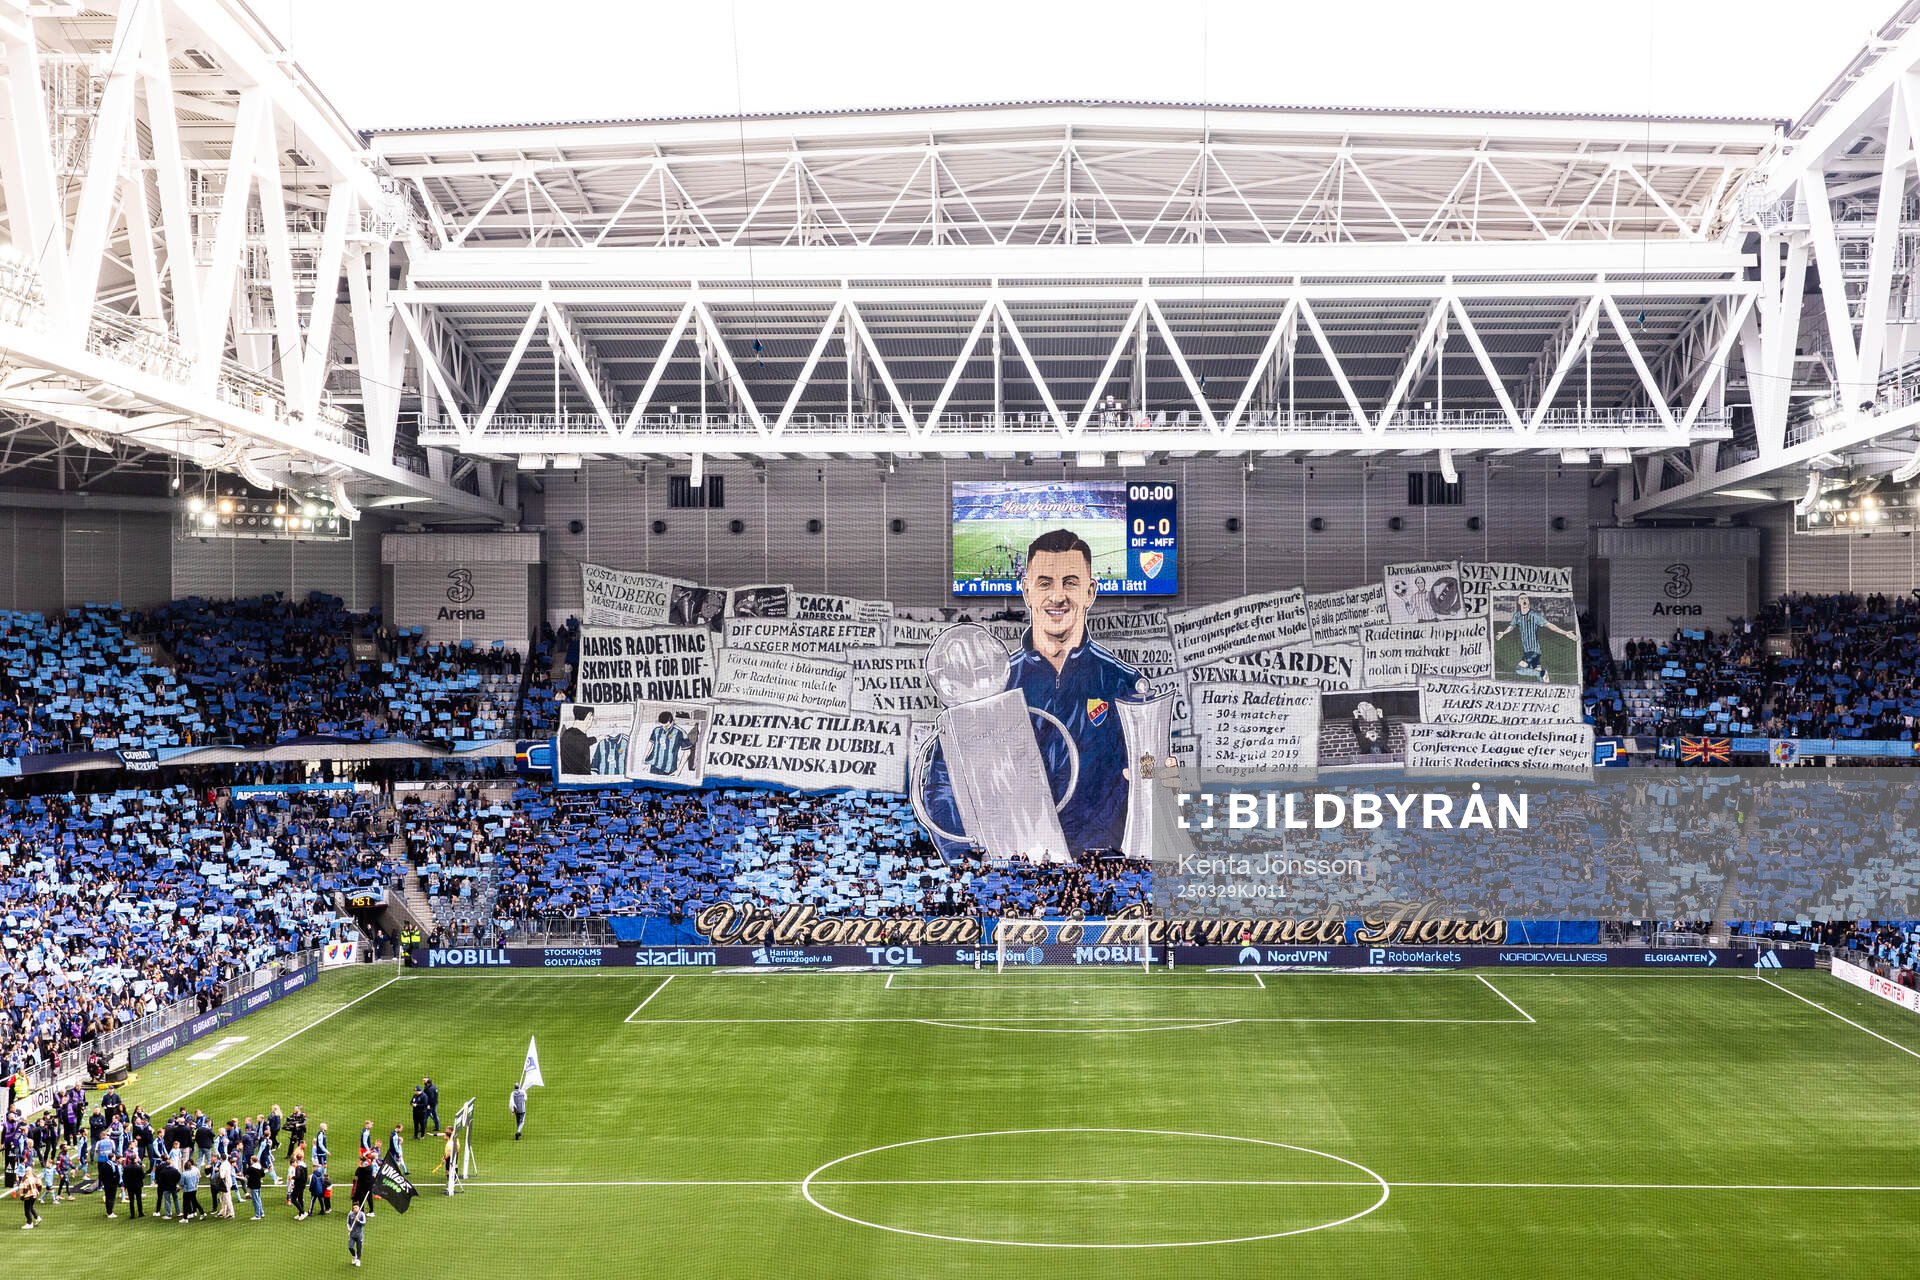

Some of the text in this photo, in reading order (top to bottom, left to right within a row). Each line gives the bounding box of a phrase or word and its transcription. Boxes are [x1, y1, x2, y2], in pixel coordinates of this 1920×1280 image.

[1129, 486, 1174, 500] 00:00
[1133, 518, 1170, 535] 0 0
[1131, 538, 1147, 547] DIF
[586, 567, 618, 582] GÖSTA
[1462, 565, 1499, 580] SVEN
[447, 568, 474, 603] 3
[980, 581, 1012, 591] finns
[1097, 580, 1147, 591] ndå lätt!
[1664, 563, 1692, 599] 3
[586, 580, 667, 606] SANDBERG
[1361, 587, 1384, 604] spelat
[437, 606, 485, 620] Arena
[1174, 592, 1301, 634] Djurgården gruppsegrare
[1336, 608, 1369, 624] positioner
[1652, 602, 1702, 616] Arena
[732, 622, 876, 638] DIF CUPMÄSTARE EFTER
[1183, 620, 1249, 648] Europaspelet
[1251, 614, 1275, 630] efter
[1277, 606, 1305, 622] Haris
[1258, 630, 1276, 642] mot
[1278, 621, 1307, 637] Molde
[1314, 625, 1348, 640] mittback
[1365, 624, 1486, 643] Radetinac hoppade
[583, 634, 706, 657] HARIS RADETINAC
[753, 642, 789, 651] SEGER
[791, 642, 818, 652] MOT
[1367, 643, 1482, 659] in som målvakt höll
[1142, 650, 1172, 663] 2020:
[582, 660, 632, 680] SKRIVER
[636, 656, 652, 677] PÅ
[655, 656, 678, 677] FÖR
[854, 659, 893, 670] HARIS
[1368, 663, 1491, 678] nollan i DIF:s cupseger
[750, 671, 799, 687] Radetinac
[1192, 667, 1247, 682] SVENSKA
[582, 677, 711, 703] NOBBAR RIVALEN
[890, 677, 921, 689] HAR
[801, 693, 847, 708] bortaplan
[873, 694, 895, 710] ÄN
[1202, 690, 1314, 706] Haris Radetinac:
[1442, 699, 1560, 713] HARIS RADETINAC
[1216, 709, 1290, 721] 304 matcher
[713, 713, 813, 730] RADETINAC
[817, 717, 901, 736] TILLBAKA
[1216, 723, 1230, 732] 12
[1411, 729, 1433, 738] DIF
[709, 732, 895, 755] I SPEL EFTER DUBBLA
[1216, 737, 1230, 746] 32
[1233, 736, 1275, 749] gjorda
[1271, 750, 1299, 759] 2019
[1412, 742, 1591, 760] Conference League efter seger
[707, 751, 877, 776] KORSBANDSKADOR
[1216, 764, 1298, 777] Cupguld 2018
[1419, 757, 1452, 767] Haris
[1454, 757, 1520, 769] Radetinacs
[1522, 760, 1549, 770] sista
[1552, 763, 1589, 774] match
[697, 901, 981, 945] Välkommen
[1056, 908, 1084, 944] i
[1354, 900, 1507, 945] Haris
[429, 949, 511, 967] MOBILL
[544, 956, 602, 966] GOLVTJÄNST
[635, 949, 716, 966] stadium
[769, 949, 804, 958] Haninge
[769, 955, 821, 964] Terrazzogolv
[866, 948, 922, 964] TCL
[1076, 946, 1158, 964] MOBILL
[1268, 951, 1328, 962] NordVPN
[1388, 951, 1461, 962] RoboMarkets
[1499, 953, 1607, 962] NORDICWELLNESS
[1644, 954, 1708, 962] ELGIGANTEN
[381, 1163, 412, 1194] UNIBET
